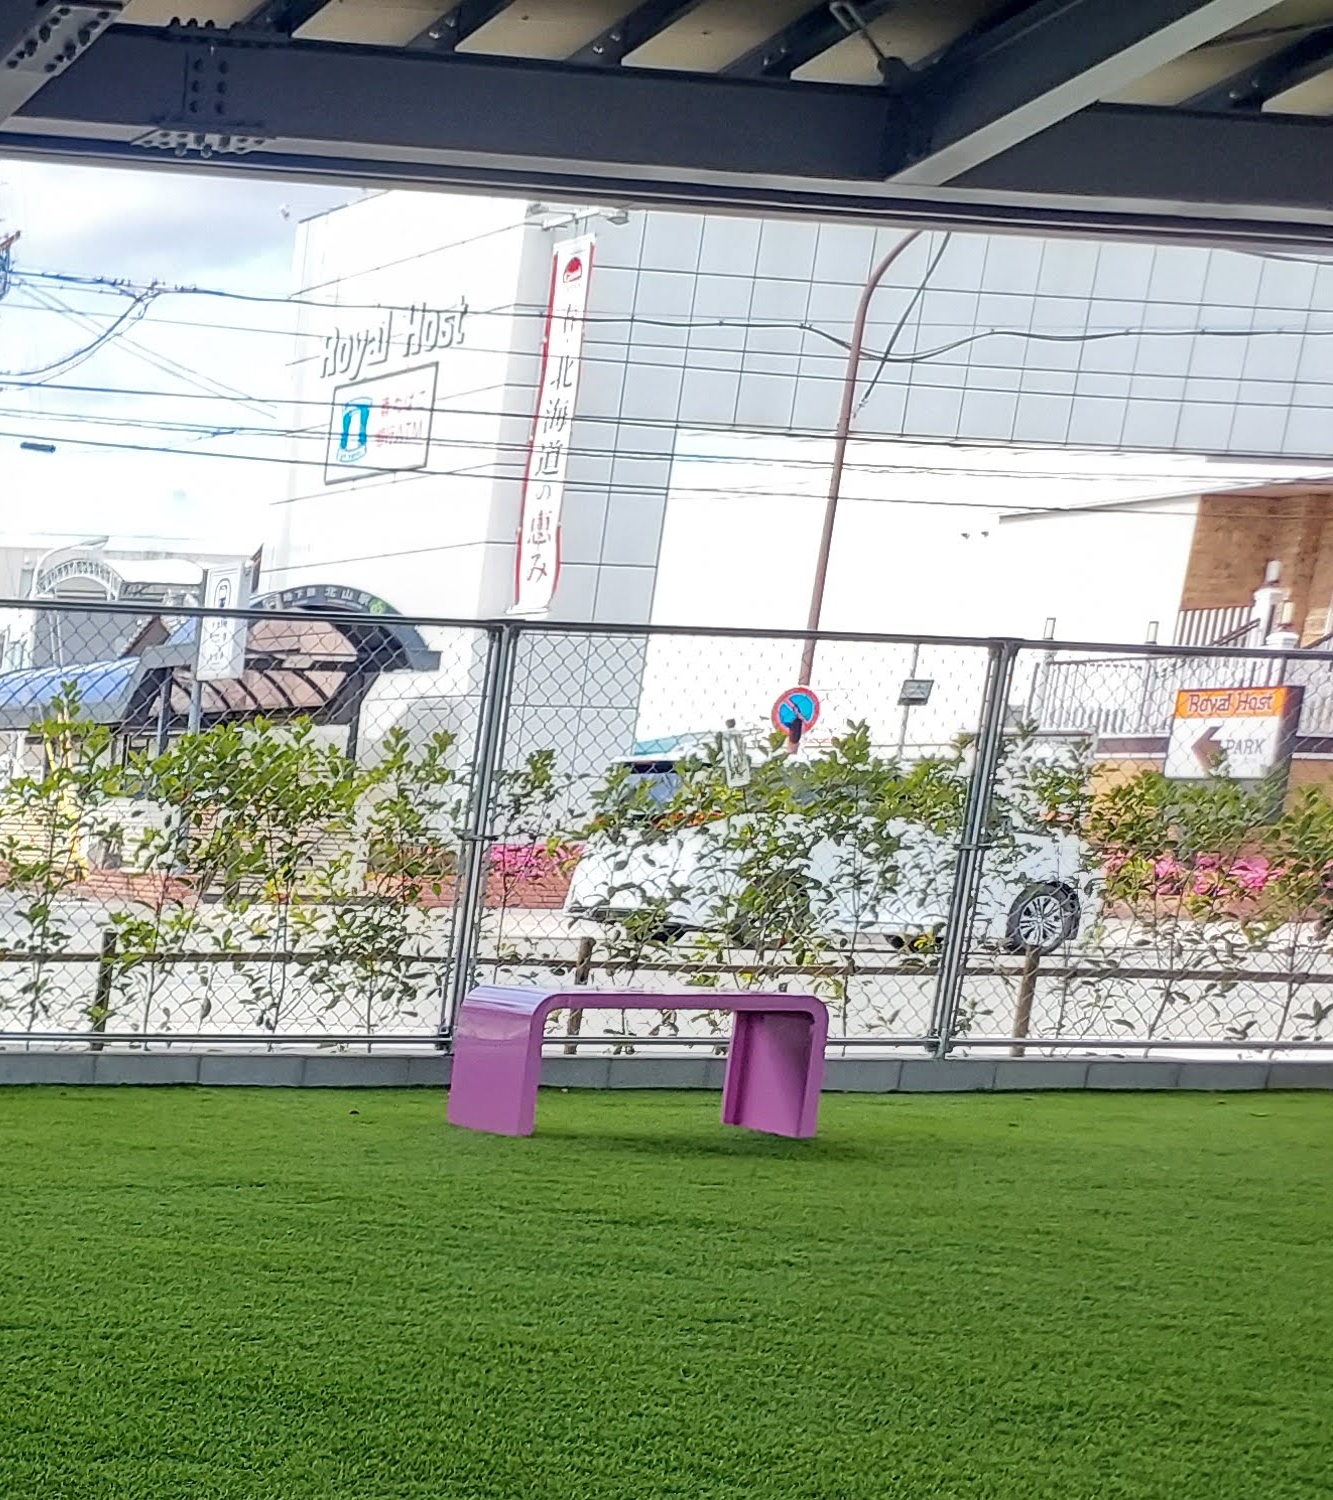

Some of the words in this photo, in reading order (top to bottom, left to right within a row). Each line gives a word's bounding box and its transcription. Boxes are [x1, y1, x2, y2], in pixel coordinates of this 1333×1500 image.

[319, 310, 394, 381] Royal
[402, 294, 469, 358] Host
[1188, 693, 1232, 714] Royal
[1235, 691, 1273, 711] Host
[1225, 738, 1266, 756] PARK
